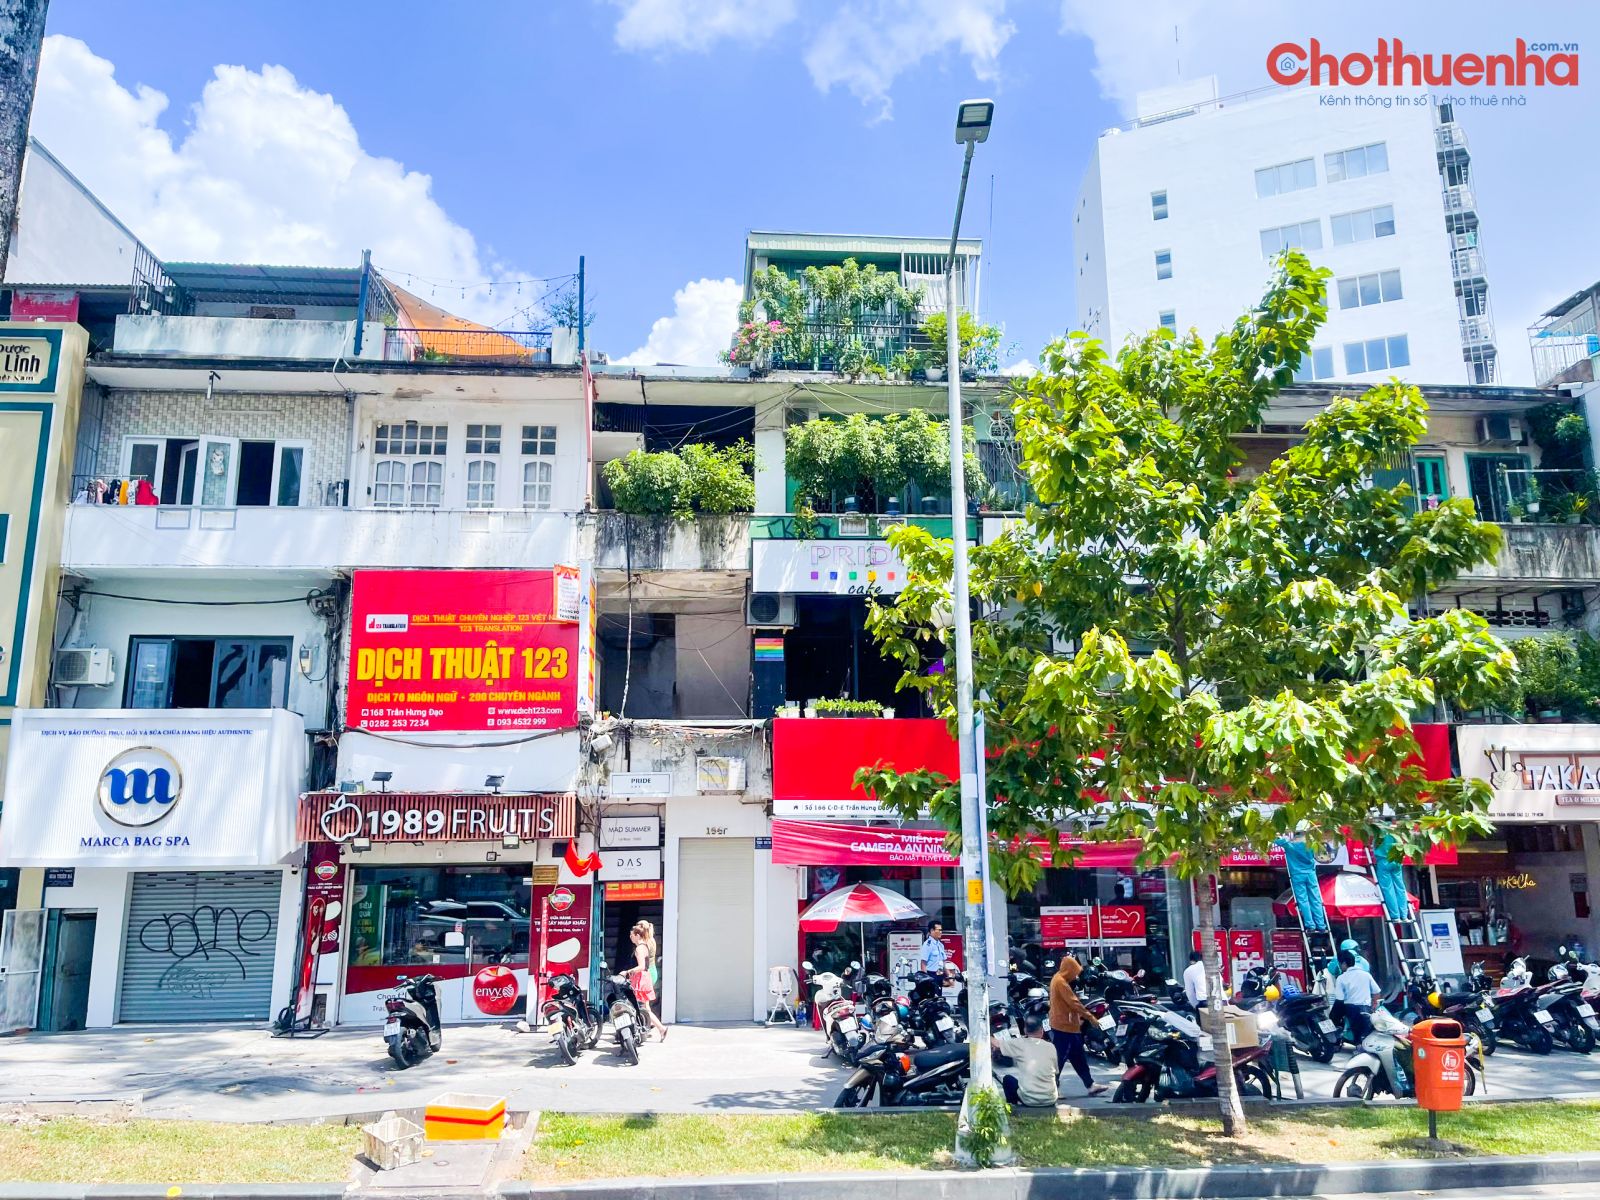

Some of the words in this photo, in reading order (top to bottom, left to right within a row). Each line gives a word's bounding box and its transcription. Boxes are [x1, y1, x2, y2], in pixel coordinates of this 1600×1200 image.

[5, 354, 41, 373] Linh
[811, 545, 904, 566] PRID
[848, 579, 884, 595] cafe
[475, 625, 523, 633] TRANSLATION
[356, 647, 423, 687] DỊCH
[430, 639, 516, 687] THUẬT
[522, 646, 569, 679] 123
[366, 692, 391, 704] DỊCH
[407, 690, 435, 703] NGÔN
[436, 689, 458, 703] NGỮ
[469, 693, 487, 702] 200
[489, 690, 527, 702] CHUYÊN
[527, 689, 561, 701] NGÀNH
[370, 709, 384, 717] 168
[386, 708, 405, 717] Trần
[406, 708, 427, 718] Hưng
[429, 708, 444, 718] Đạo
[369, 720, 390, 728] 0282
[392, 719, 408, 728] 253
[409, 719, 430, 727] 7234
[497, 718, 512, 726] 093
[513, 718, 532, 726] 4532
[366, 809, 445, 836] 1989
[451, 808, 556, 834] FRUITS
[624, 825, 652, 833] SUMMER
[80, 837, 130, 847] MARCA
[134, 836, 162, 847] BAG
[166, 836, 191, 847] SPA
[850, 841, 902, 853] CAMERA
[904, 842, 922, 854] AN
[924, 843, 949, 854] NIN
[1234, 938, 1248, 946] 4G
